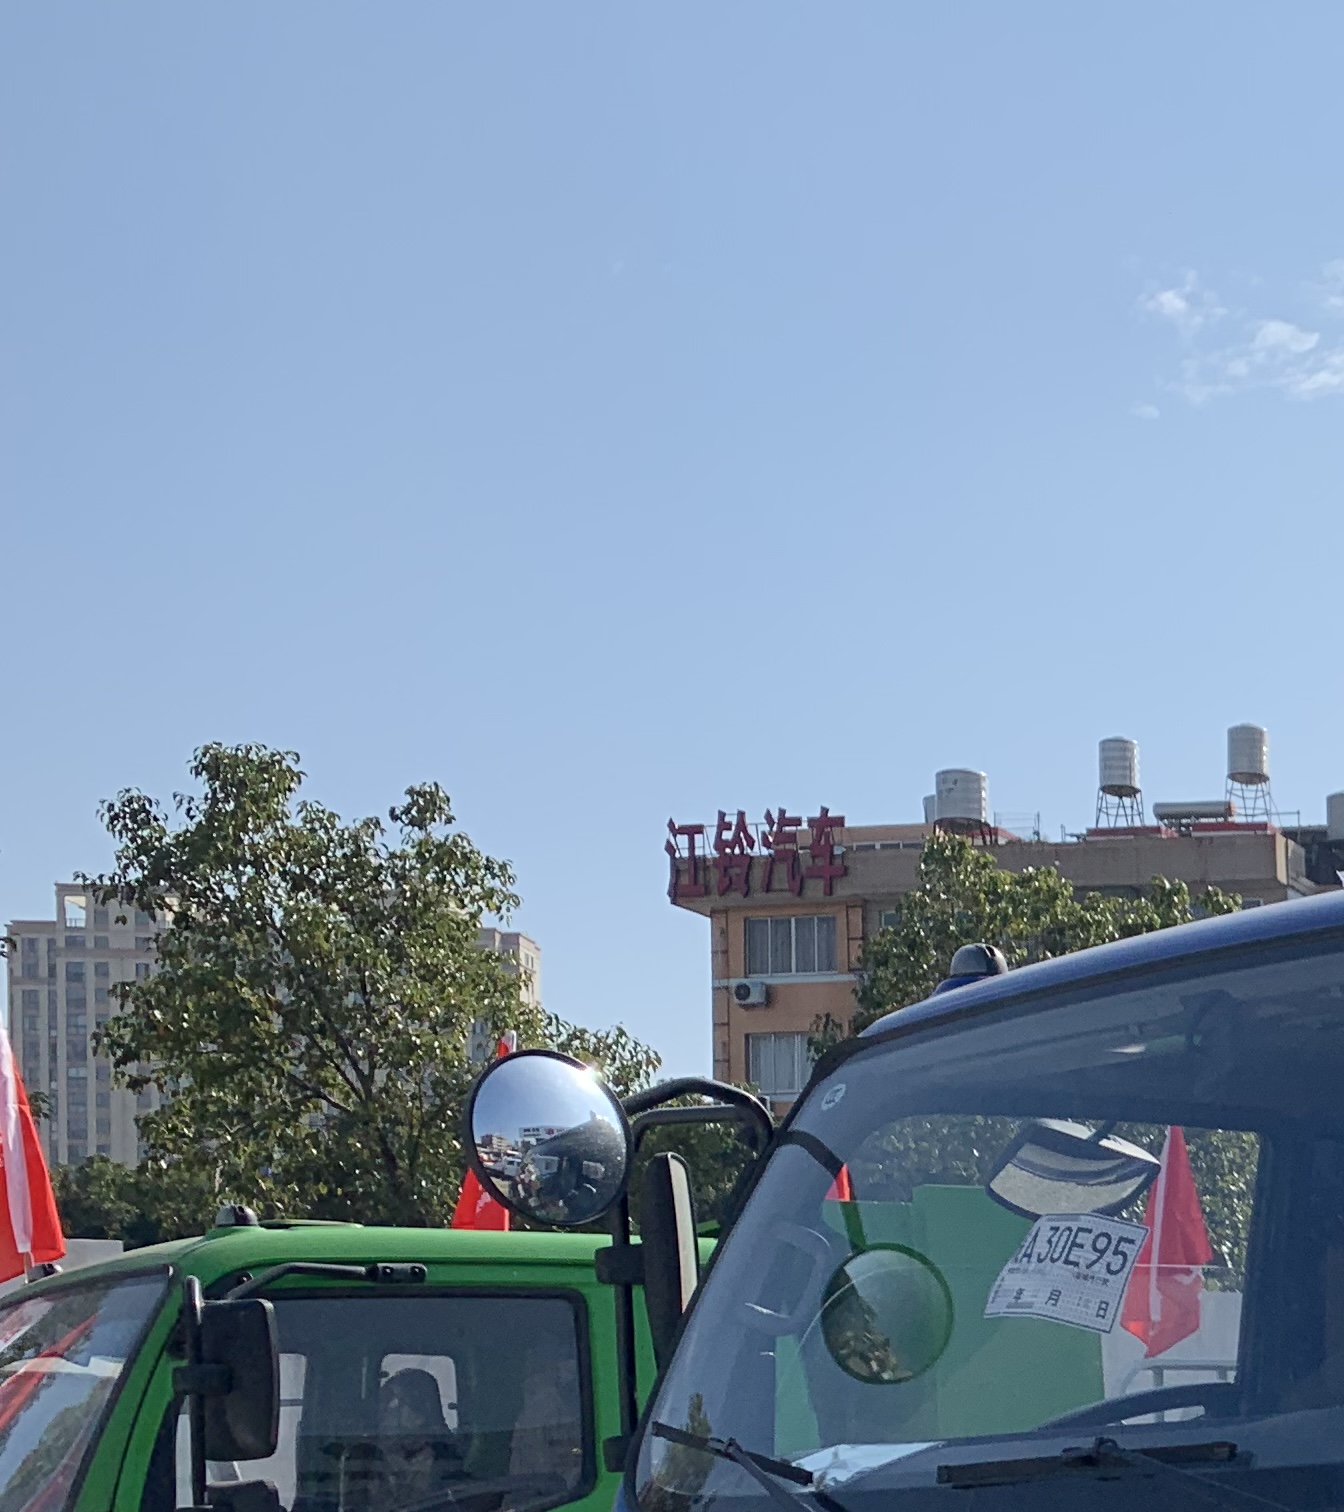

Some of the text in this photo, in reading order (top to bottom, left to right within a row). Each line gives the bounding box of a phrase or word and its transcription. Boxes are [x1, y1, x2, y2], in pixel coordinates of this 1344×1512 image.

[664, 805, 848, 898] 江铃汽车
[1014, 1226, 1136, 1276] A30E95
